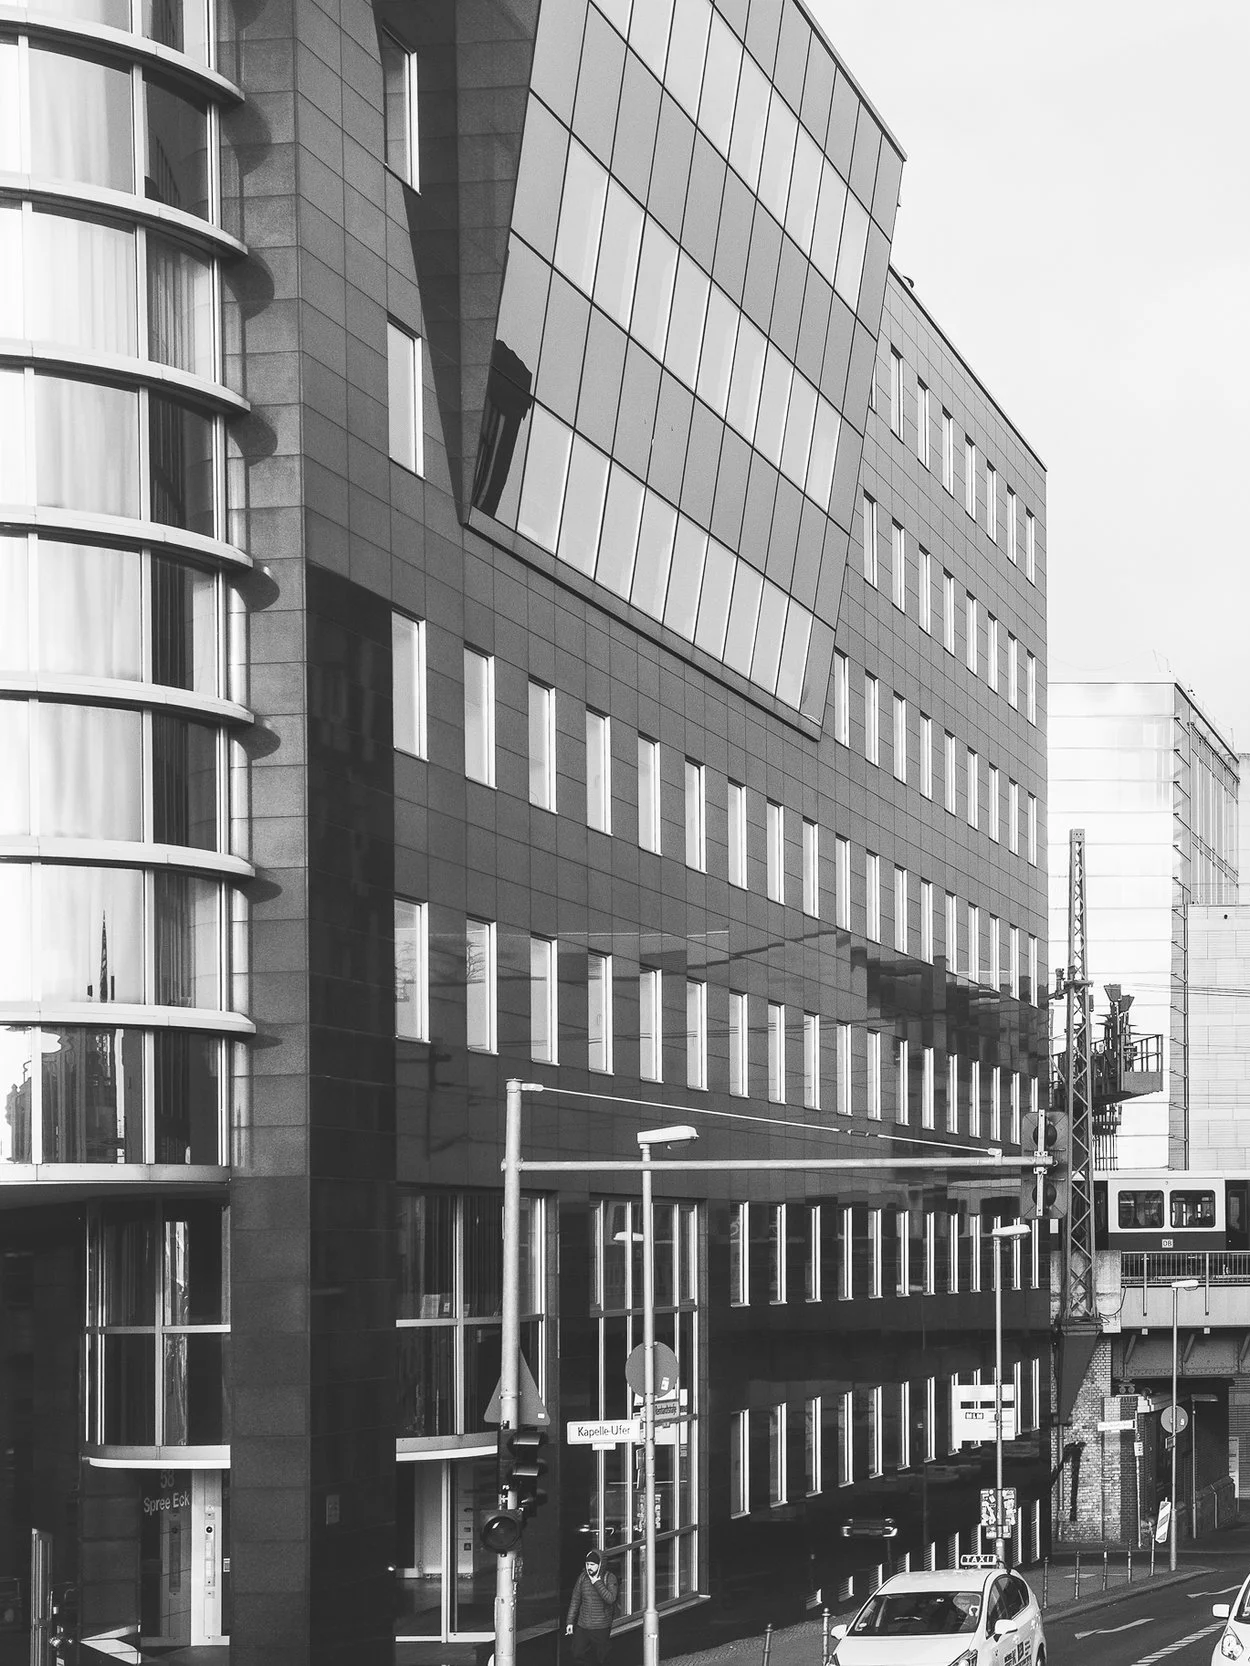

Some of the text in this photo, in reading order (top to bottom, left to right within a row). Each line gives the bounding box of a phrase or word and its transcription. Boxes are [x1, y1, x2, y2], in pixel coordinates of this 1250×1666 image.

[577, 1425, 631, 1439] Kapelle-Ufer
[160, 1469, 175, 1488] 58
[143, 1491, 190, 1515] Spree Eck
